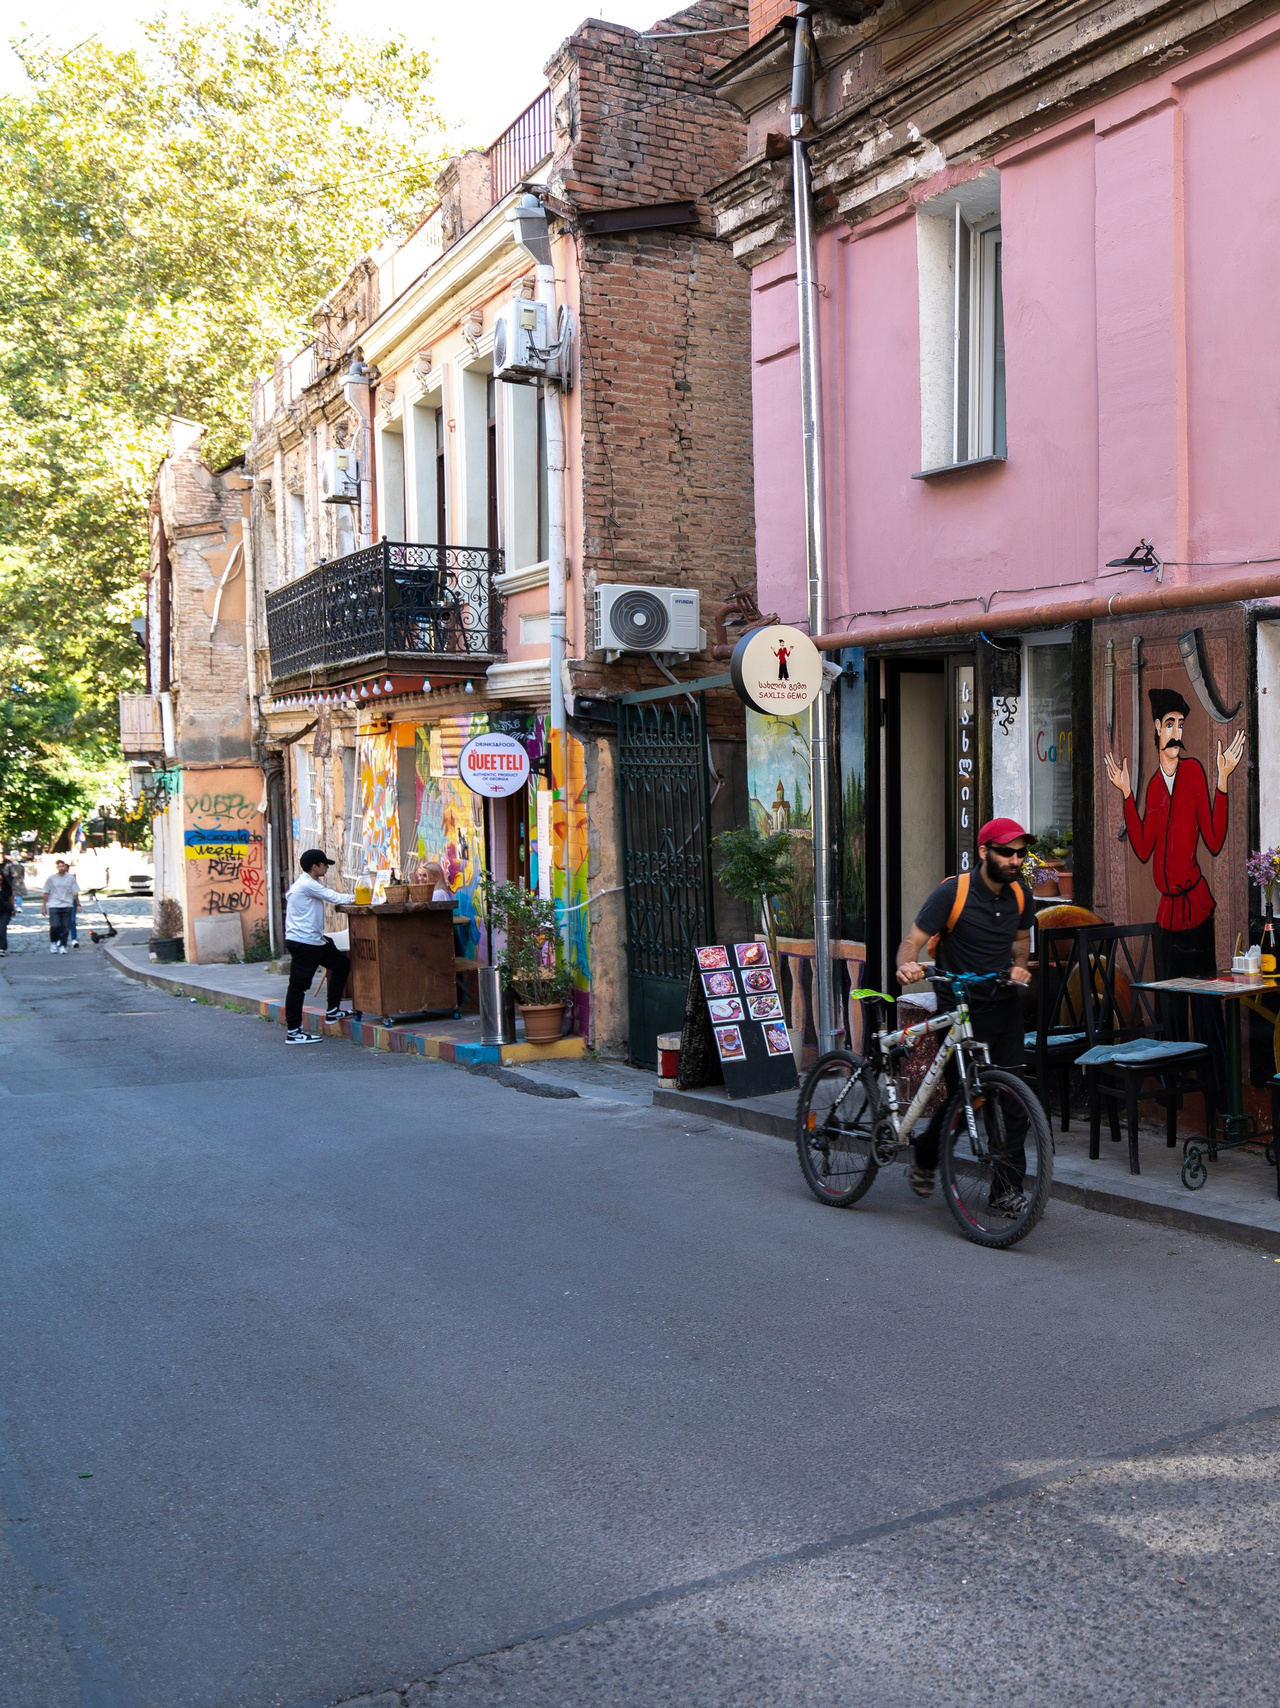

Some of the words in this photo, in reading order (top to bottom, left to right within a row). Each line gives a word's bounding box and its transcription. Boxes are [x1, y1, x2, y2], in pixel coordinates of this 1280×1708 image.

[758, 692, 785, 700] SAXLIS
[787, 692, 807, 700] GEMO
[1036, 730, 1072, 762] Coff
[468, 754, 522, 771] QUEETELI
